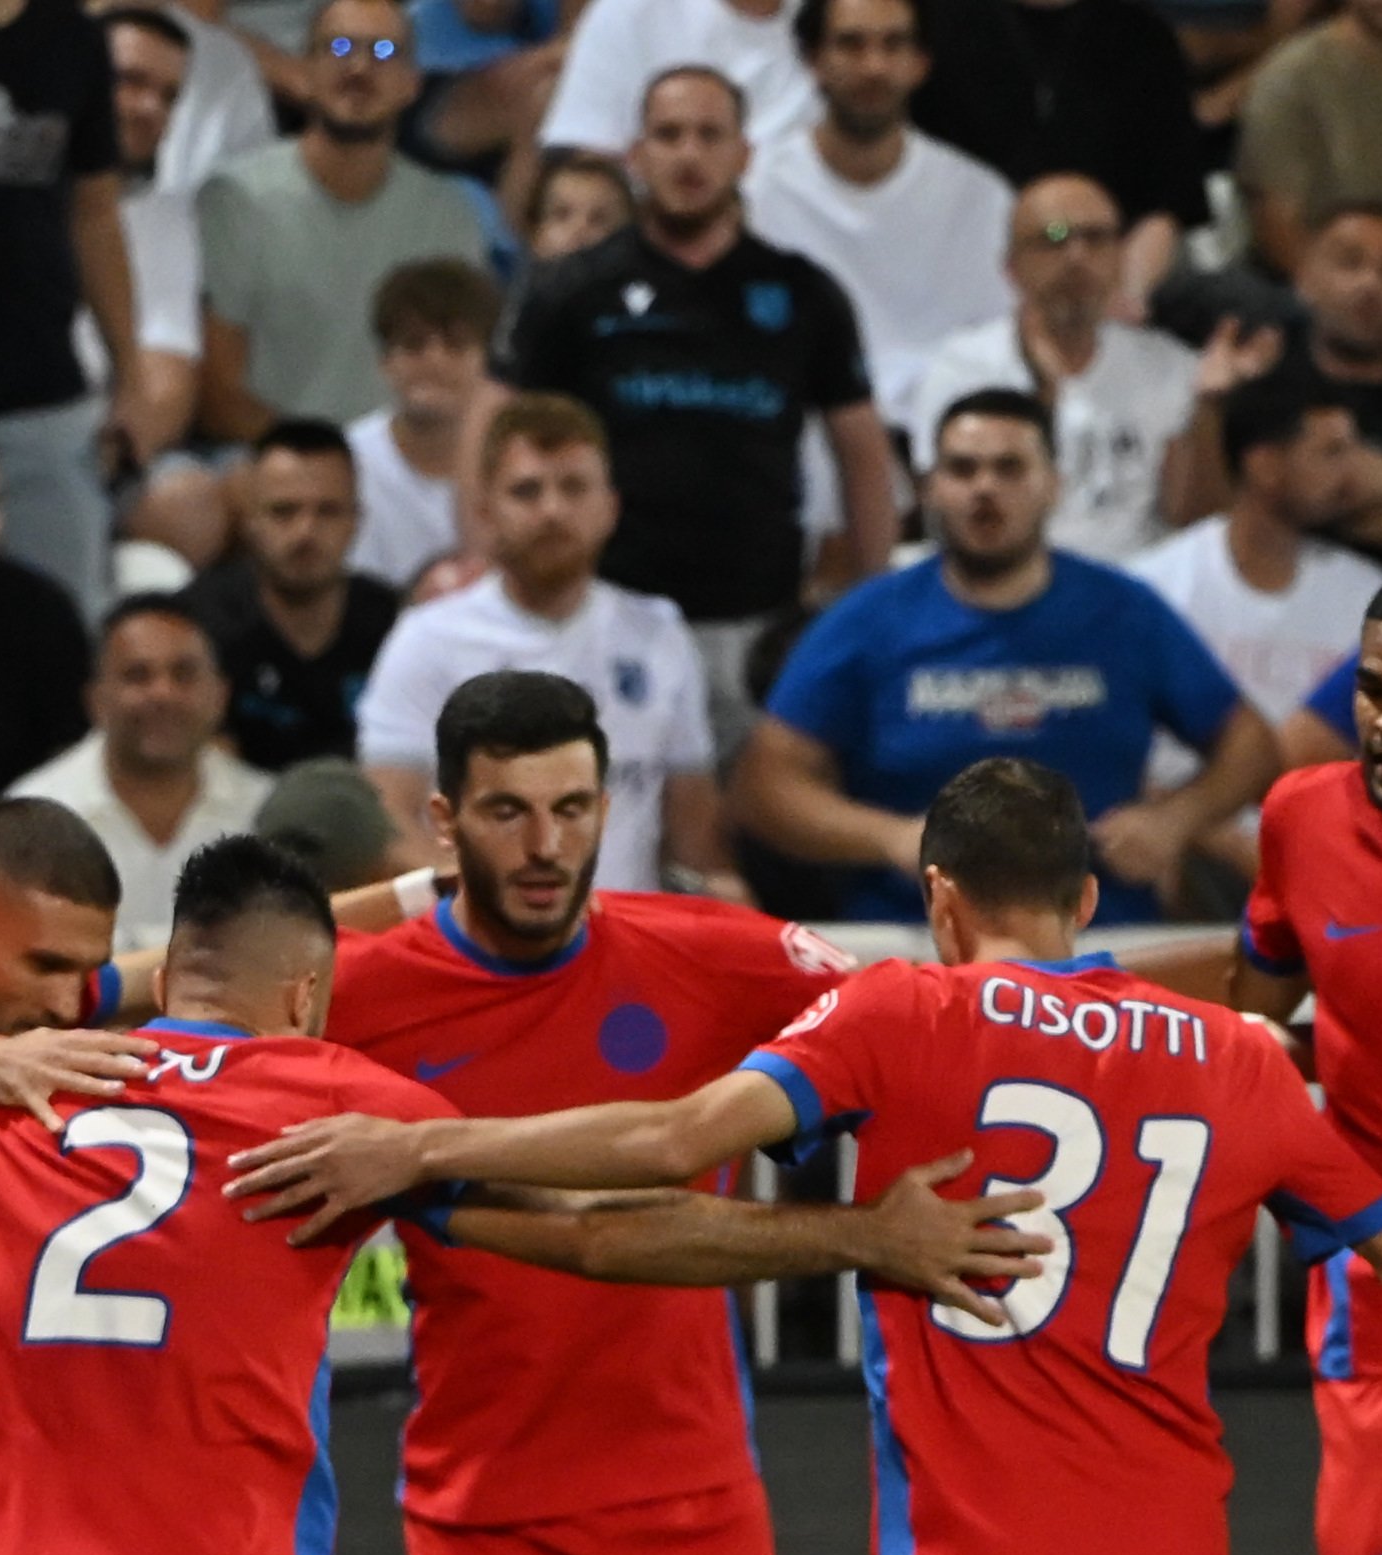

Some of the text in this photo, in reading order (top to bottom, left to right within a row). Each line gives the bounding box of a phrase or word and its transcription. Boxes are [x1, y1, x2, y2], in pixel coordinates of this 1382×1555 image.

[981, 975, 1207, 1063] CISOTTI
[22, 1103, 195, 1347] 2
[928, 1077, 1212, 1372] 31
